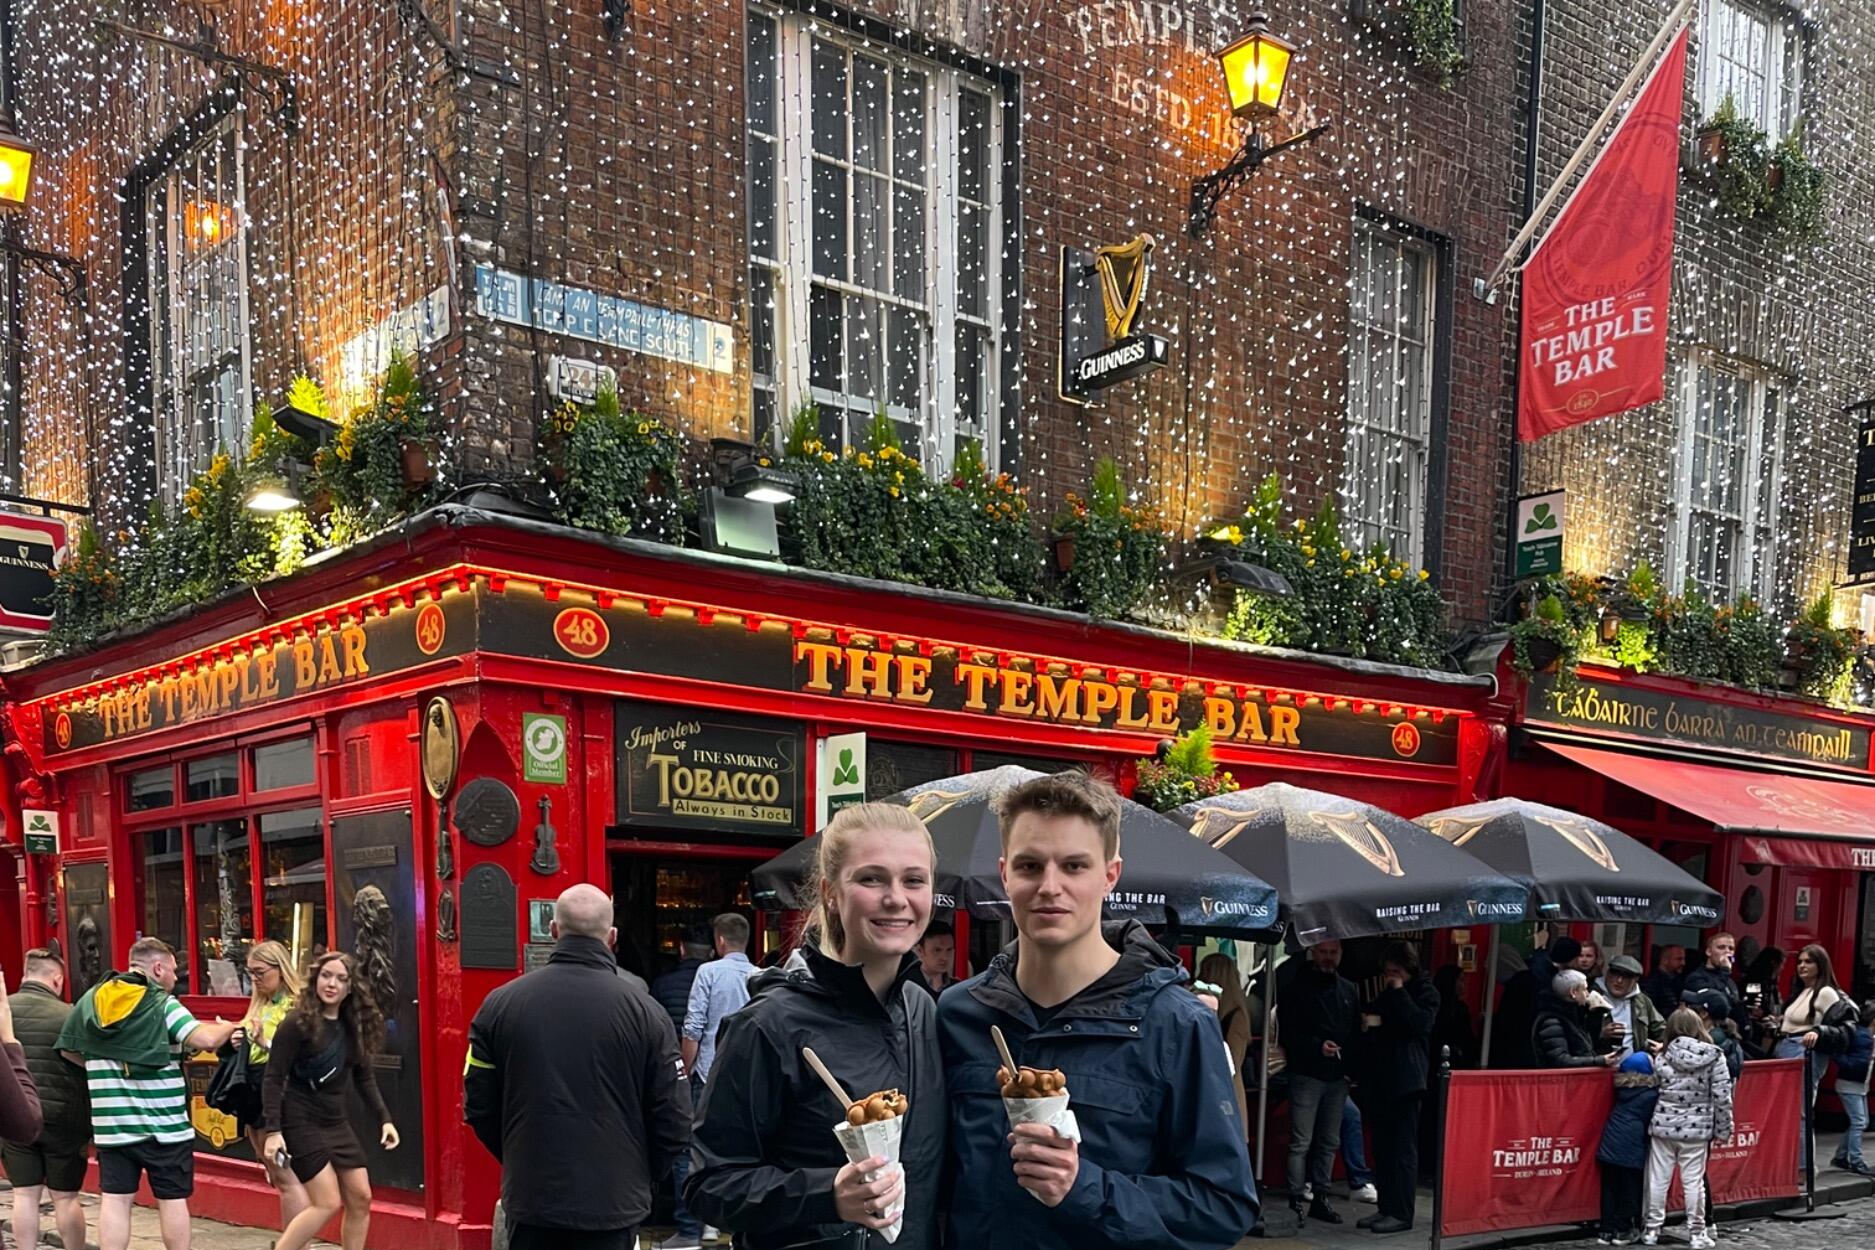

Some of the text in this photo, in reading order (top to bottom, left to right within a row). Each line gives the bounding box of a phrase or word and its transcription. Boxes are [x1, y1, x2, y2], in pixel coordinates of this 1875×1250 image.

[572, 296, 591, 313] AN
[1563, 295, 1617, 328] THE
[1530, 305, 1656, 369] TEMPLE
[1079, 341, 1146, 381] GUINNESS
[1553, 346, 1619, 387] BAR
[0, 555, 49, 571] GUINNESS
[420, 615, 440, 646] 48
[562, 614, 598, 647] 48
[99, 626, 371, 738] THE TEMPLE BAR
[795, 640, 1301, 747] THE TEMPLE BAR
[624, 720, 702, 753] Importers
[672, 739, 687, 751] OF
[1395, 728, 1414, 750] 48
[693, 749, 779, 770] FINE SMOKING
[645, 753, 780, 807] TOBACCO
[674, 800, 791, 822] Always in Stock
[1125, 892, 1144, 905] THE
[1146, 893, 1167, 906] BAR
[1214, 899, 1269, 918] GUINNESS
[1477, 901, 1523, 916] GUINNESS
[1375, 902, 1441, 919] RAISING THE BAR
[1679, 903, 1718, 919] GUINNESS
[1530, 1136, 1553, 1150] THE
[1492, 1147, 1581, 1168] TEMPLE BAR
